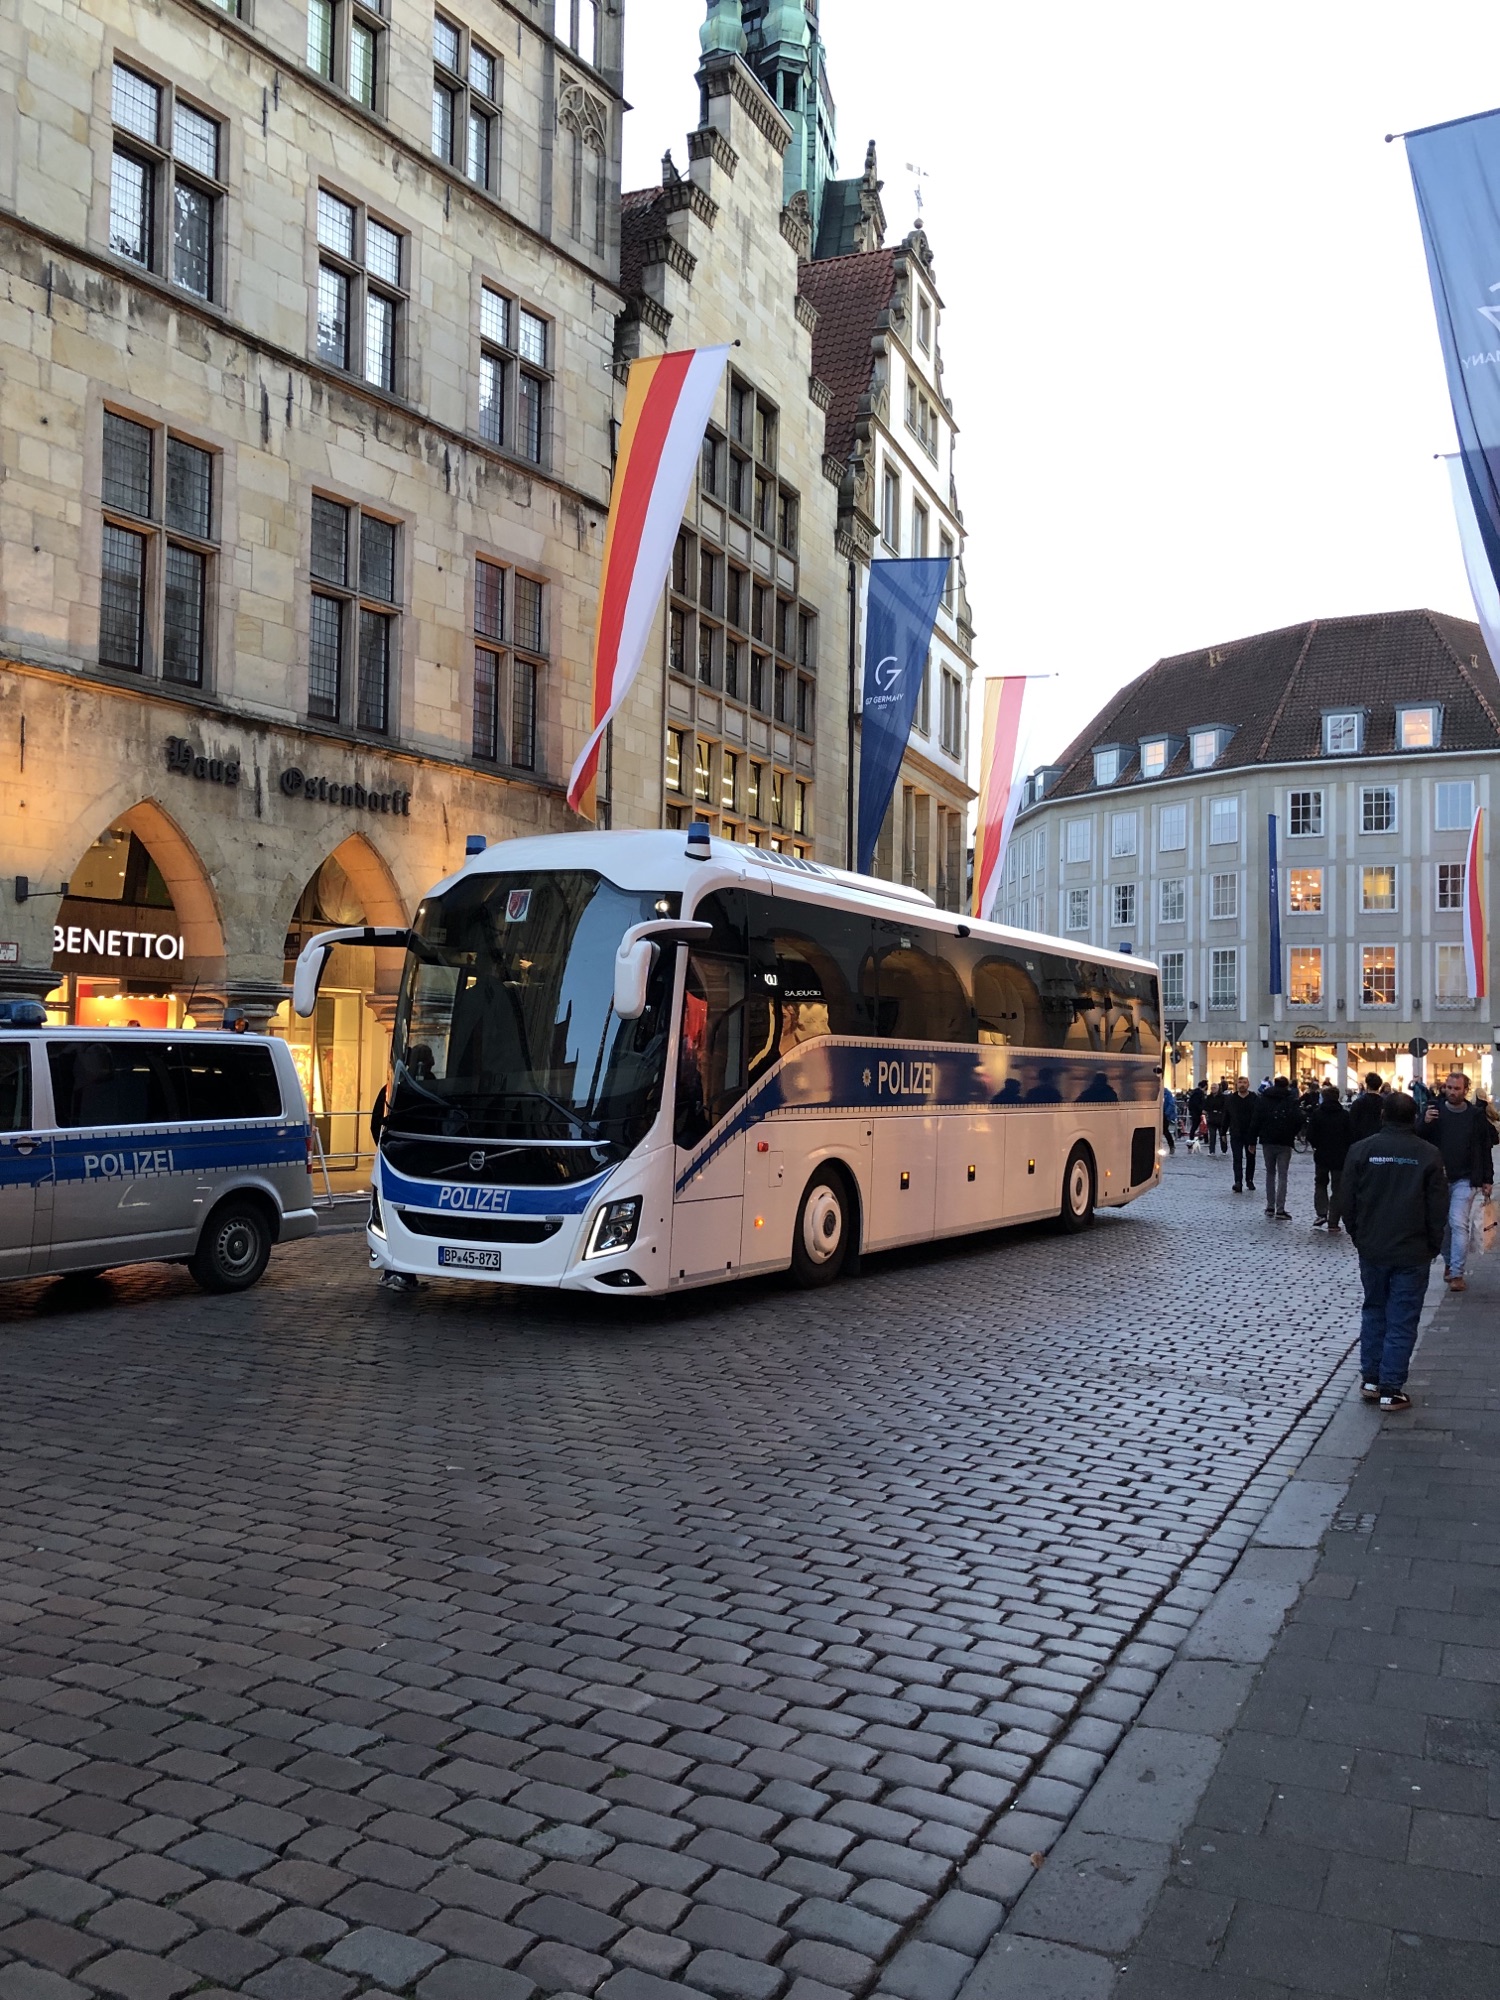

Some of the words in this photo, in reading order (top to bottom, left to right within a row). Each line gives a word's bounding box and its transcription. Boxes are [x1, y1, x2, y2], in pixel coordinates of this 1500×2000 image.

[167, 736, 241, 784] Haus
[53, 925, 184, 960] BENETTO
[878, 1061, 936, 1095] POLIZEI
[84, 1149, 174, 1178] POLIZEI
[438, 1186, 511, 1212] POLIZEI
